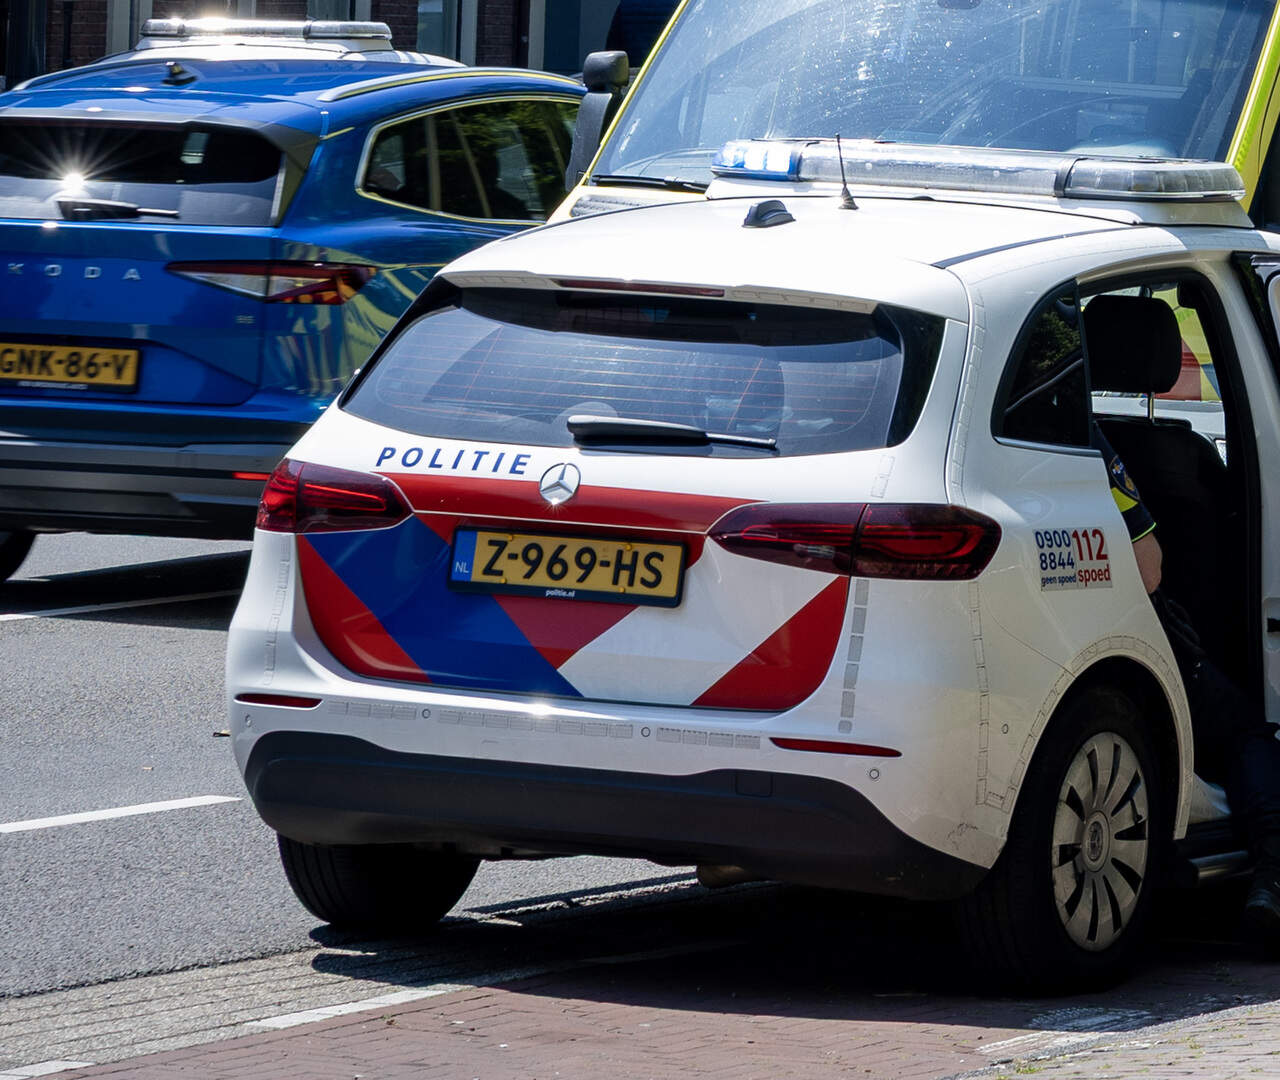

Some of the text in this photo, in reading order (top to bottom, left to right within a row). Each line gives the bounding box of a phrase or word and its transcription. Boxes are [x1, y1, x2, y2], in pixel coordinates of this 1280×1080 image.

[8, 262, 142, 281] KODA
[376, 446, 532, 475] POLITIE
[1035, 529, 1071, 549] 0900
[1072, 528, 1109, 561] 112
[455, 561, 469, 574] NL
[482, 539, 665, 589] Z-969-HS
[1039, 552, 1075, 571] 8844
[1041, 573, 1077, 587] geen spoed
[1078, 564, 1111, 587] spoed
[545, 588, 576, 599] politie.nl
